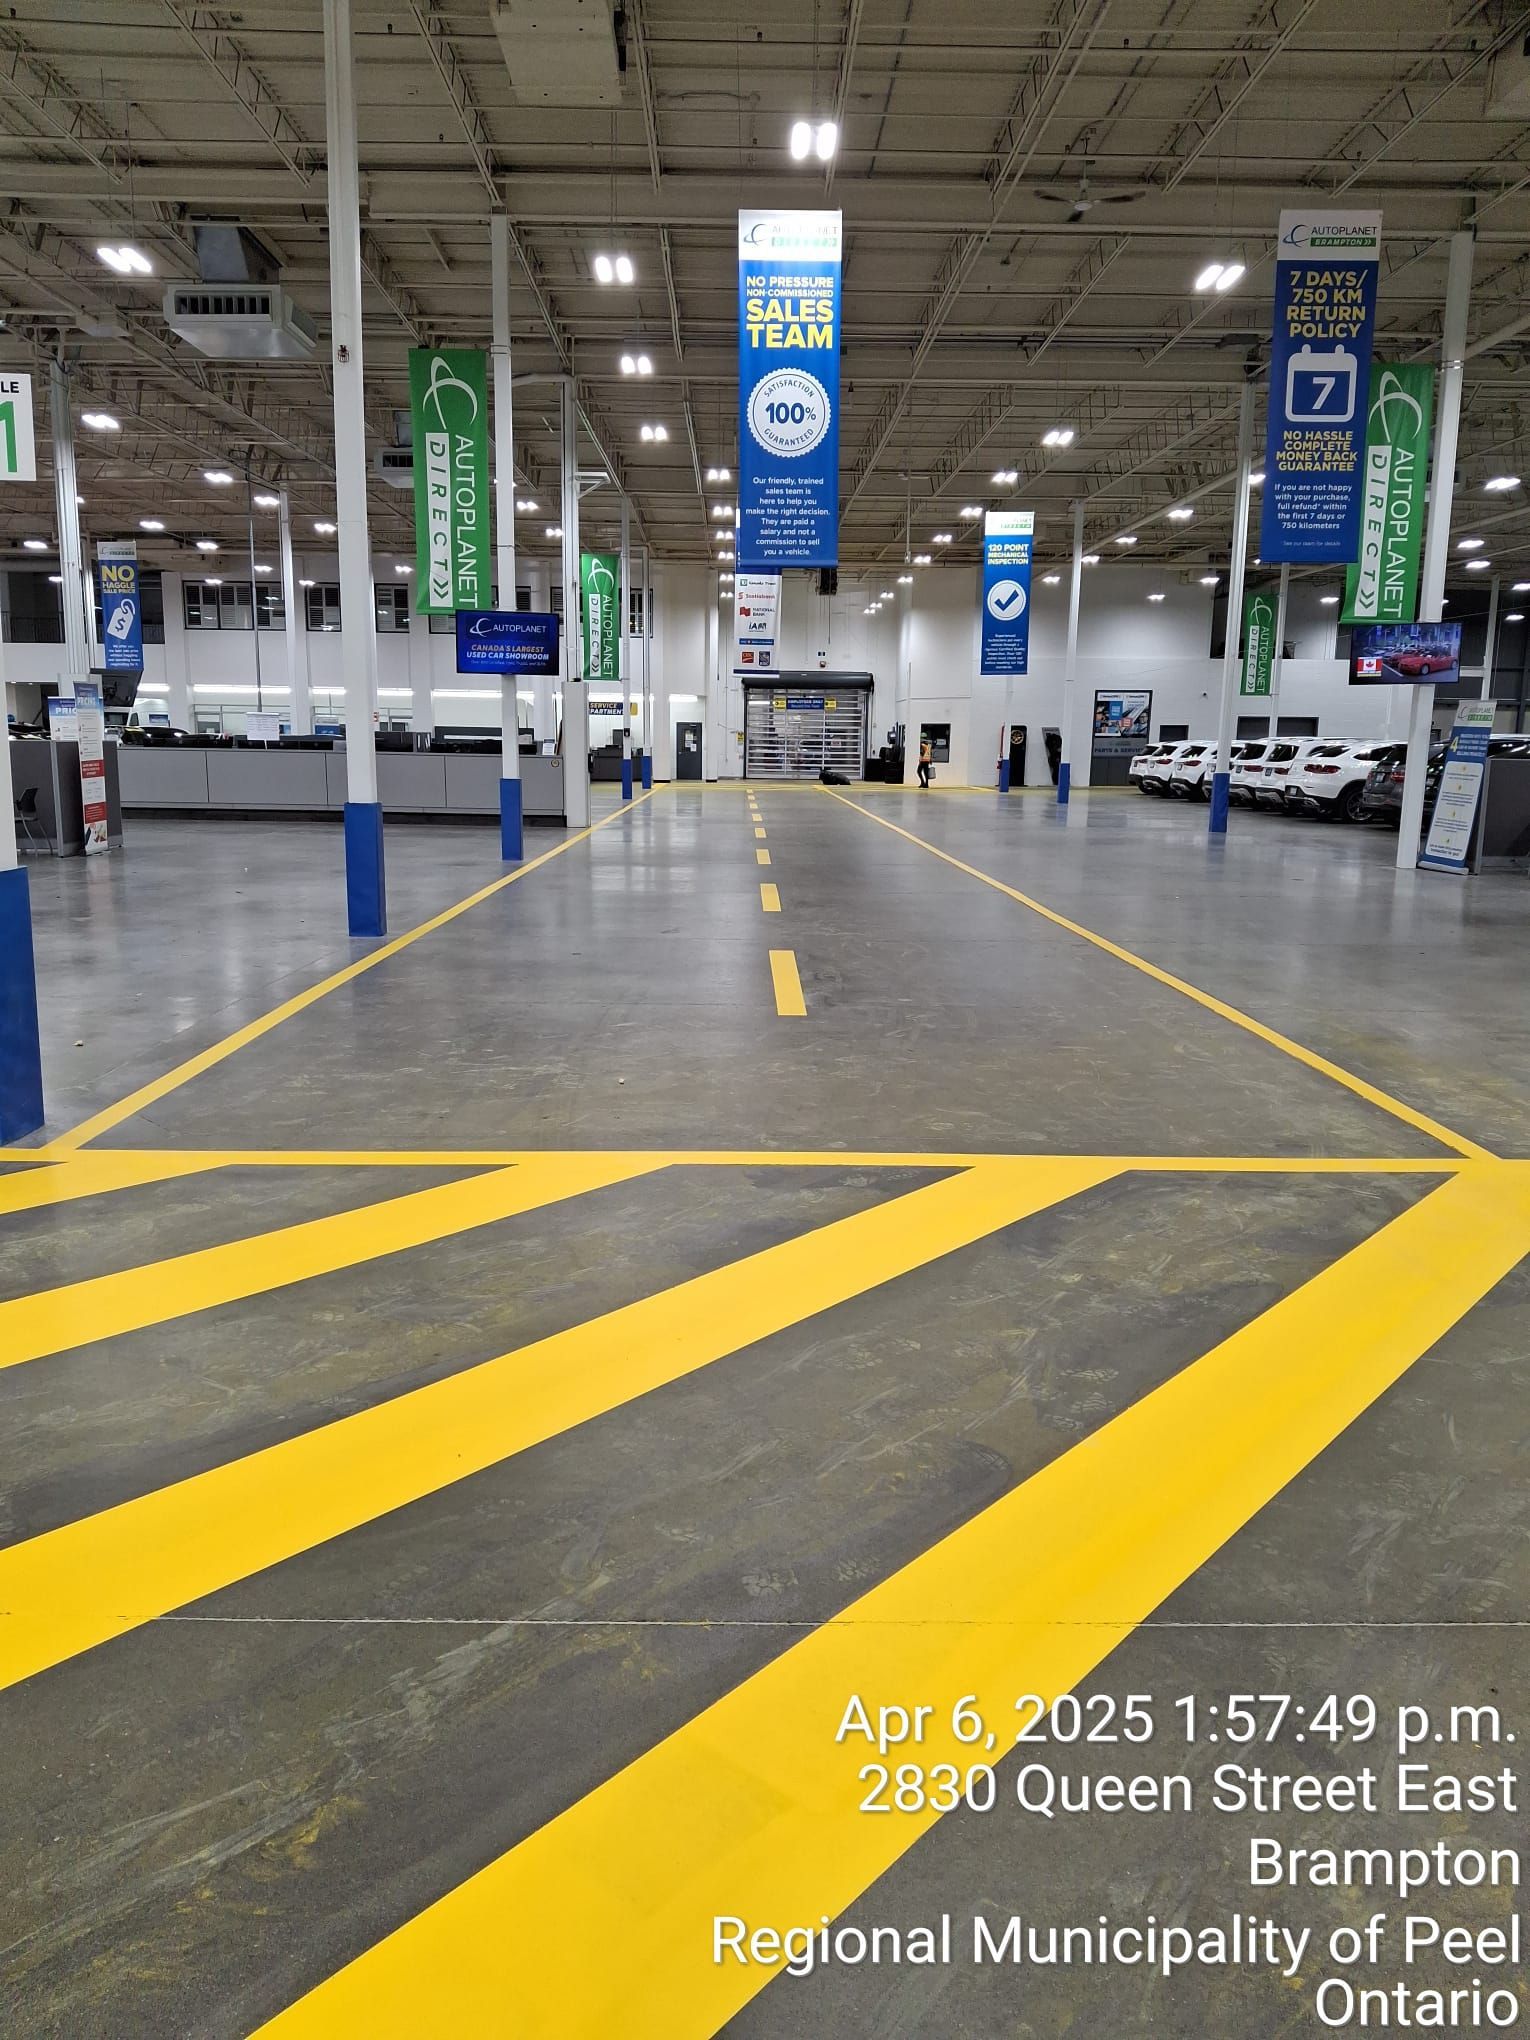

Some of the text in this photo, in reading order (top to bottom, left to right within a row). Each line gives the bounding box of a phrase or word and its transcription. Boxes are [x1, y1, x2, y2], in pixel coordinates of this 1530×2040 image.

[1311, 226, 1377, 236] AUTOPLANET
[1314, 238, 1363, 246] BRAMPTON
[746, 276, 834, 288] NO PRESSURE
[1290, 270, 1368, 288] 7 DAYS/
[746, 289, 834, 298] NON-COMMISSIONED
[1292, 288, 1363, 304] 750 KM
[746, 298, 834, 323] SALES
[1286, 306, 1366, 321] RETURN
[1289, 322, 1362, 338] POLICY
[746, 324, 833, 349] TEAM
[764, 379, 815, 398] SATISFACTION
[1312, 377, 1336, 410] 7
[766, 402, 816, 424] 100%
[764, 428, 814, 446] GUARANTEED
[1284, 430, 1353, 440] NO HASSLE
[1284, 441, 1350, 451] COMPLETE
[1276, 451, 1358, 461] MONEY BACK
[1278, 462, 1354, 472] GUARANTEE
[752, 476, 766, 484] Our
[768, 477, 796, 486] friendly,
[1328, 484, 1352, 492] happy
[786, 498, 802, 506] help
[1294, 494, 1311, 502] your
[1314, 494, 1350, 502] purchase,
[430, 440, 449, 575] DIRECT
[780, 508, 797, 516] right
[1278, 502, 1290, 510] full
[1322, 502, 1347, 510] within
[455, 434, 479, 608] AUTOPLANET
[761, 518, 778, 526] They
[793, 518, 808, 526] paid
[1278, 512, 1290, 520] the
[1292, 512, 1308, 520] first
[1310, 512, 1315, 520] 7
[1316, 512, 1335, 520] days
[1364, 454, 1388, 582] DIRECT
[760, 528, 780, 536] salary
[1383, 448, 1414, 618] AUTOPLANET
[988, 544, 1002, 552] 120
[102, 565, 134, 582] NO
[493, 624, 546, 634] AUTOPLANET
[591, 598, 600, 663] DIRECT
[602, 594, 614, 678] AUTOPLANET
[472, 644, 510, 652] CANADA'S
[1248, 628, 1258, 679] DIRECT
[505, 652, 550, 660] SHOWROOM
[1256, 626, 1270, 694] AUTOPLANET
[1450, 736, 1459, 752] 4
